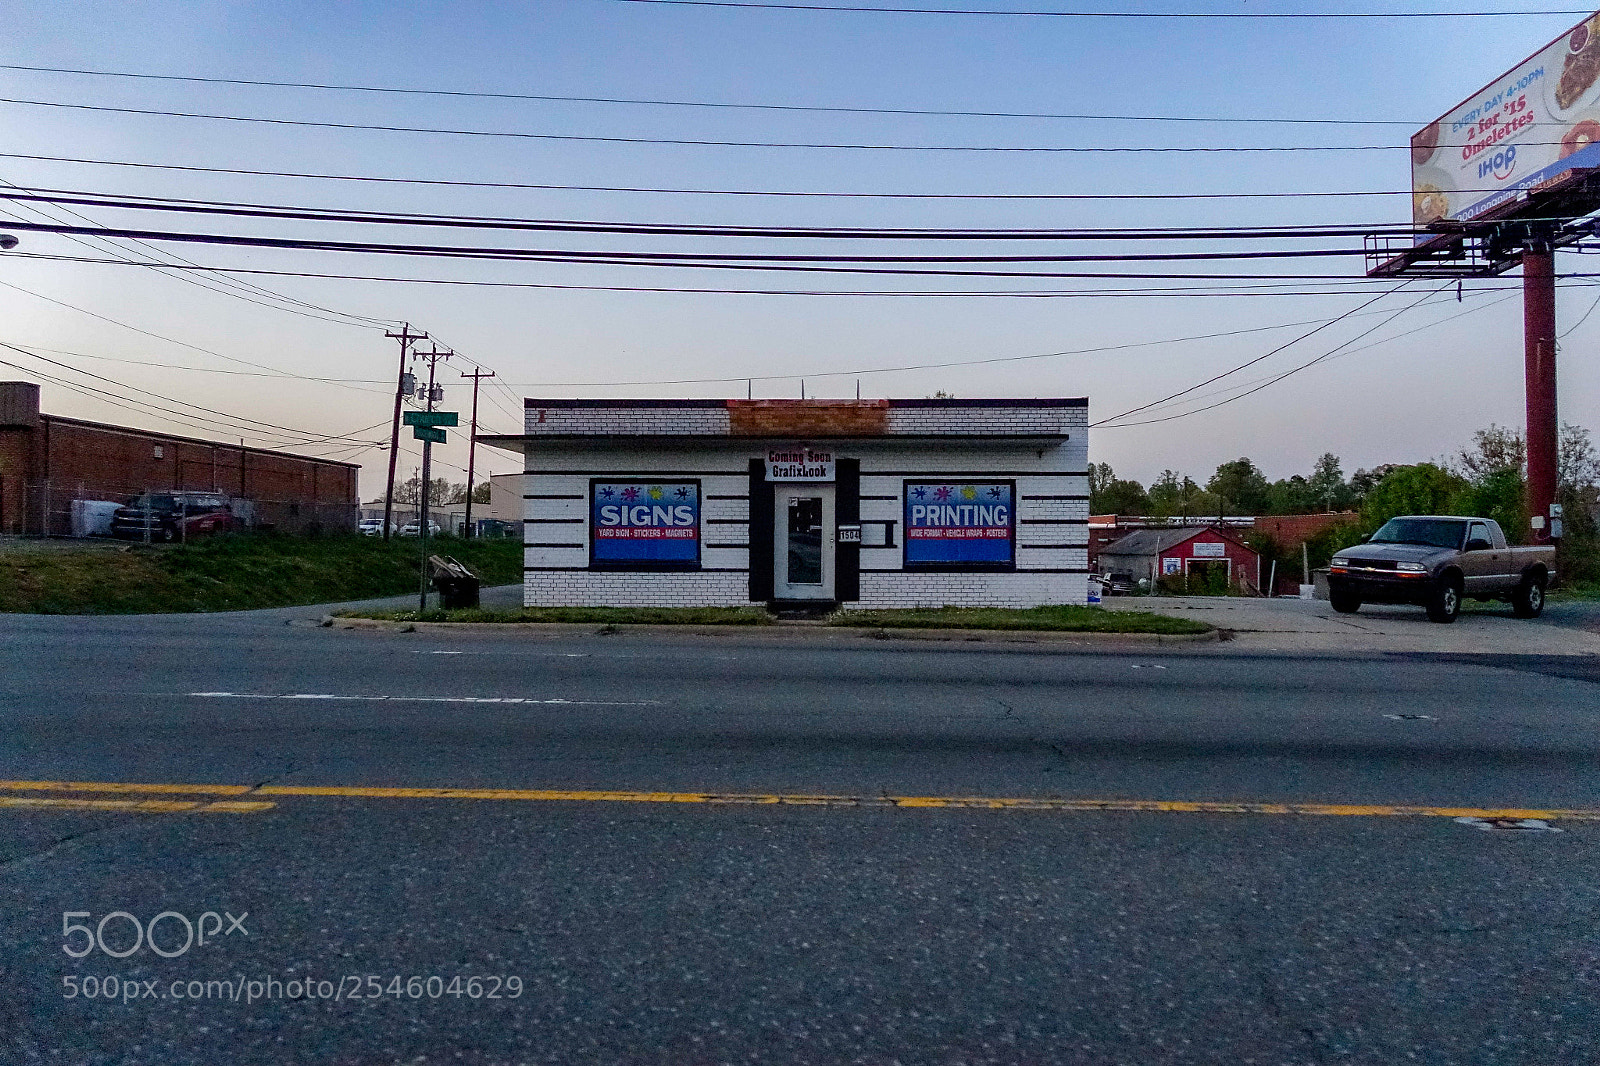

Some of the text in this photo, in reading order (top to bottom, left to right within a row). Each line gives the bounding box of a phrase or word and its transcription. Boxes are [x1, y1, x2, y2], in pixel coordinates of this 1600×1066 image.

[1452, 66, 1544, 133] EVERY DAY 4-10PM
[1467, 94, 1526, 141] 2 for $15
[1462, 110, 1534, 160] Omelettes
[769, 451, 831, 465] Coming Soon
[773, 465, 827, 477] GrafixLook
[600, 505, 694, 526] SIGNS
[912, 505, 1008, 526] PRINTING
[599, 528, 693, 537] YARD SIGN STICKERS MAGNETS
[841, 531, 859, 540] 1504
